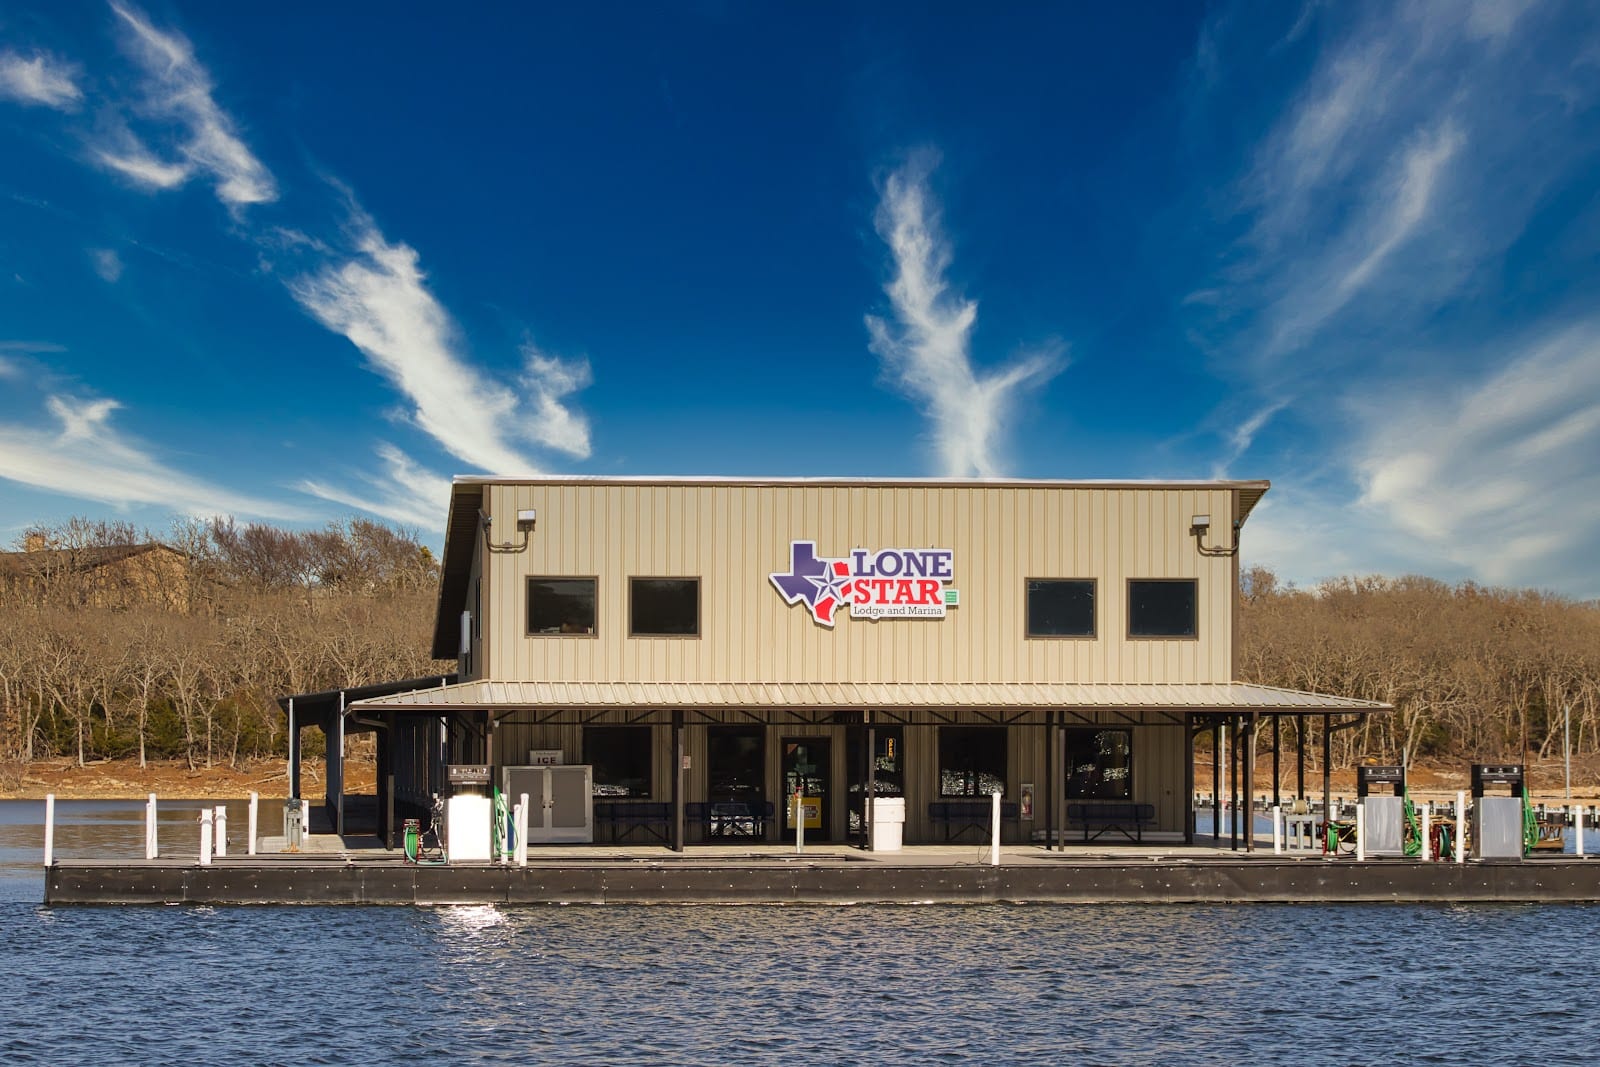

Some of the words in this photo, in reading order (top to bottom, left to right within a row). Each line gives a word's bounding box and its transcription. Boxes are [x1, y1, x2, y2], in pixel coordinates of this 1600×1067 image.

[853, 551, 952, 577] LONE
[854, 579, 942, 605] STAR
[854, 606, 885, 616] Lodge
[887, 606, 906, 615] and
[908, 606, 942, 615] Marina
[537, 756, 557, 764] ICE
